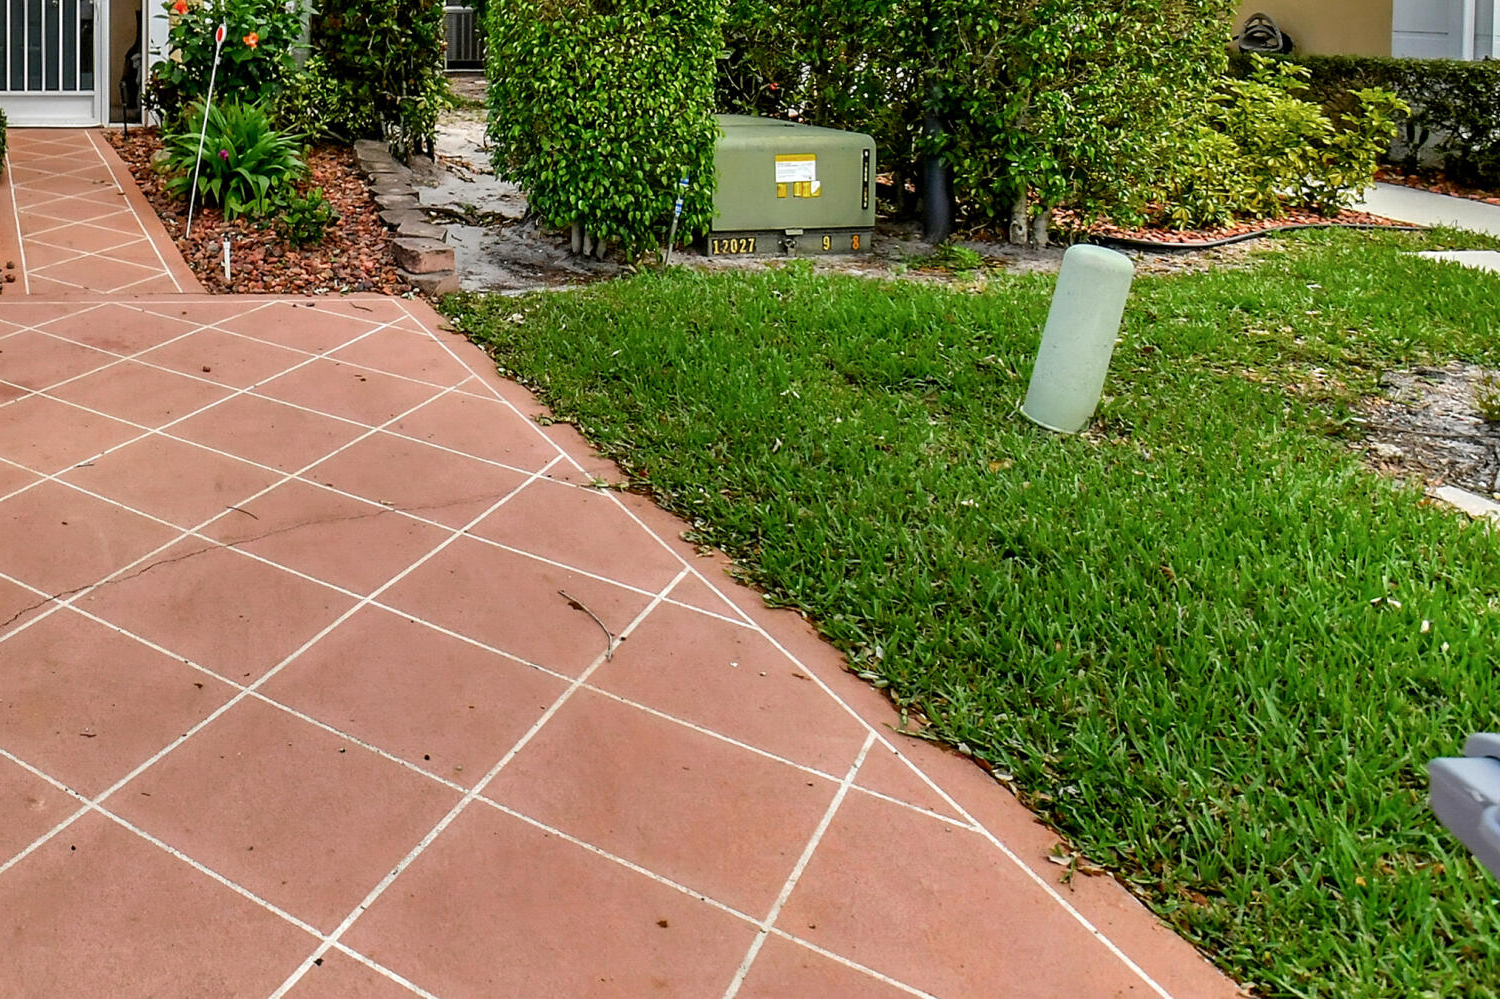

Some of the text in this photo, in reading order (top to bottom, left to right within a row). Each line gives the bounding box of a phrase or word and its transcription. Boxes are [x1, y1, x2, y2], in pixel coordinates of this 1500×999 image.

[713, 234, 860, 254] 12027 9 8
